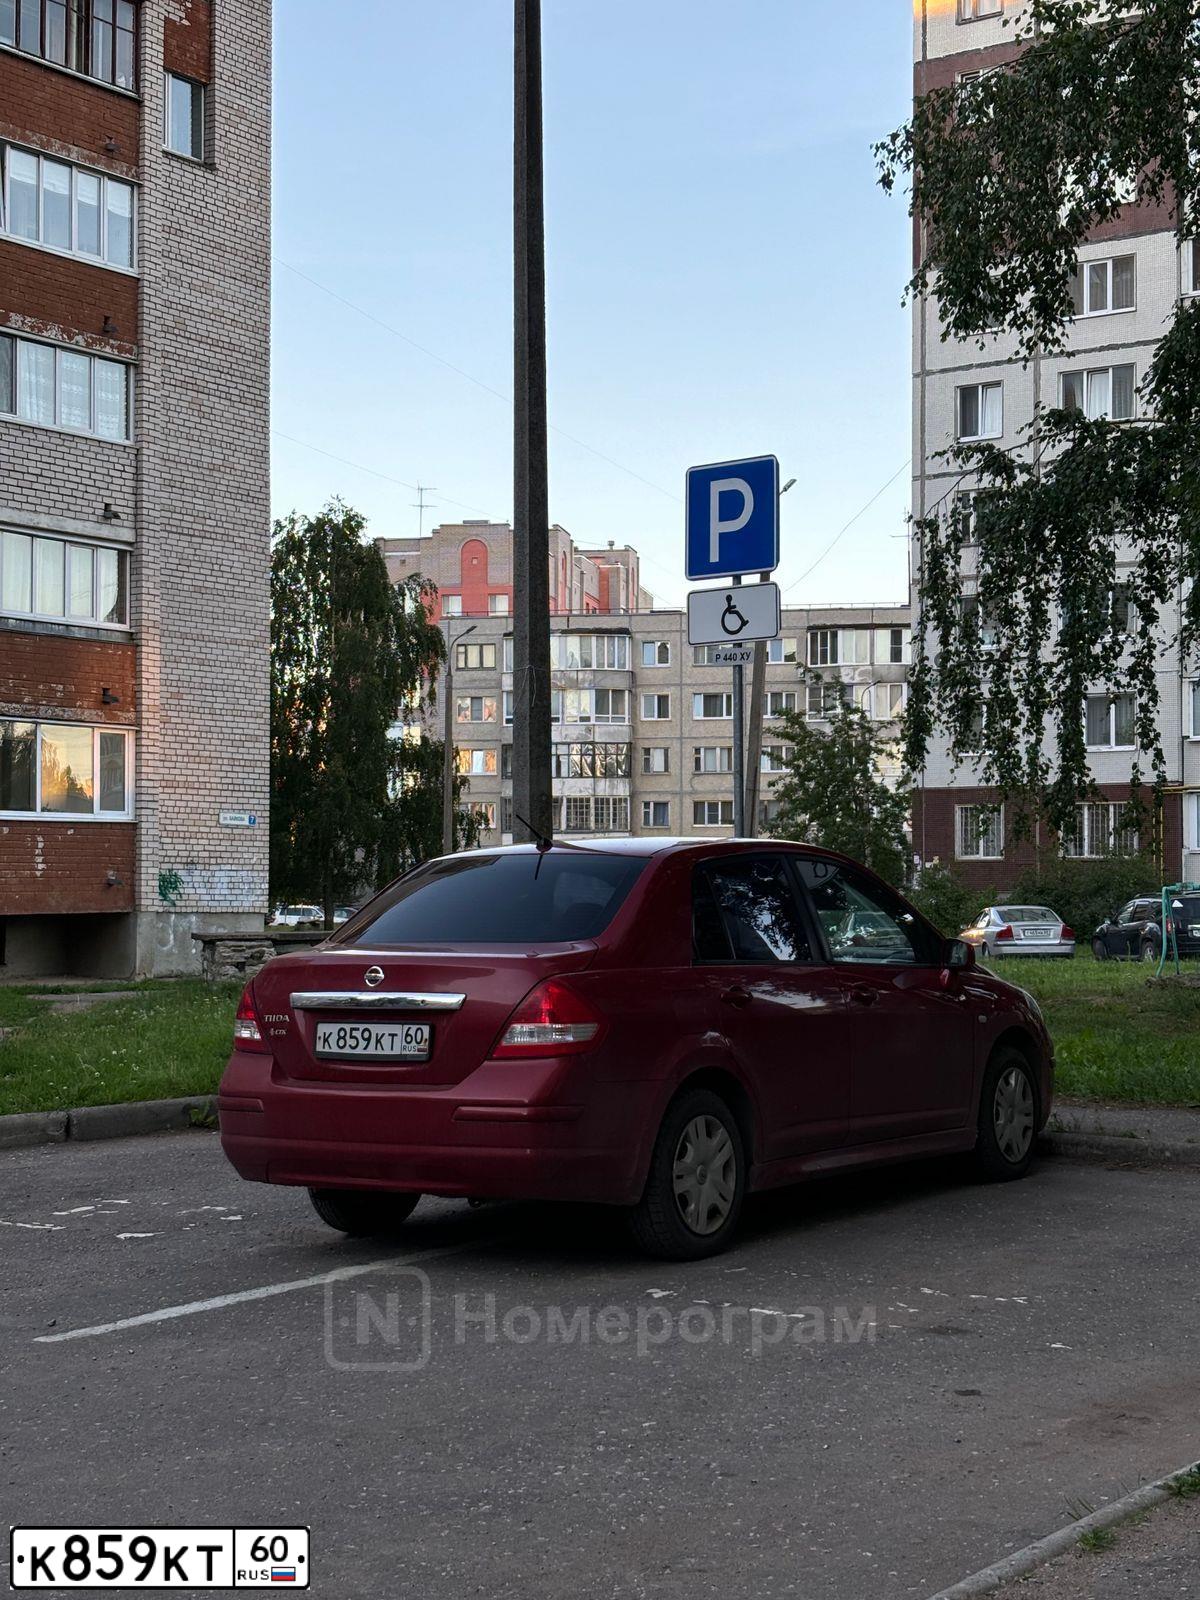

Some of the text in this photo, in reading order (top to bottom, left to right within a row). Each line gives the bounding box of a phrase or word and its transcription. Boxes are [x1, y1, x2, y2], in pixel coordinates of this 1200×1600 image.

[709, 477, 755, 563] P
[715, 651, 752, 662] Р 440 ХУ
[264, 1014, 290, 1022] TIIDA
[322, 1026, 424, 1051] К859КТ 60
